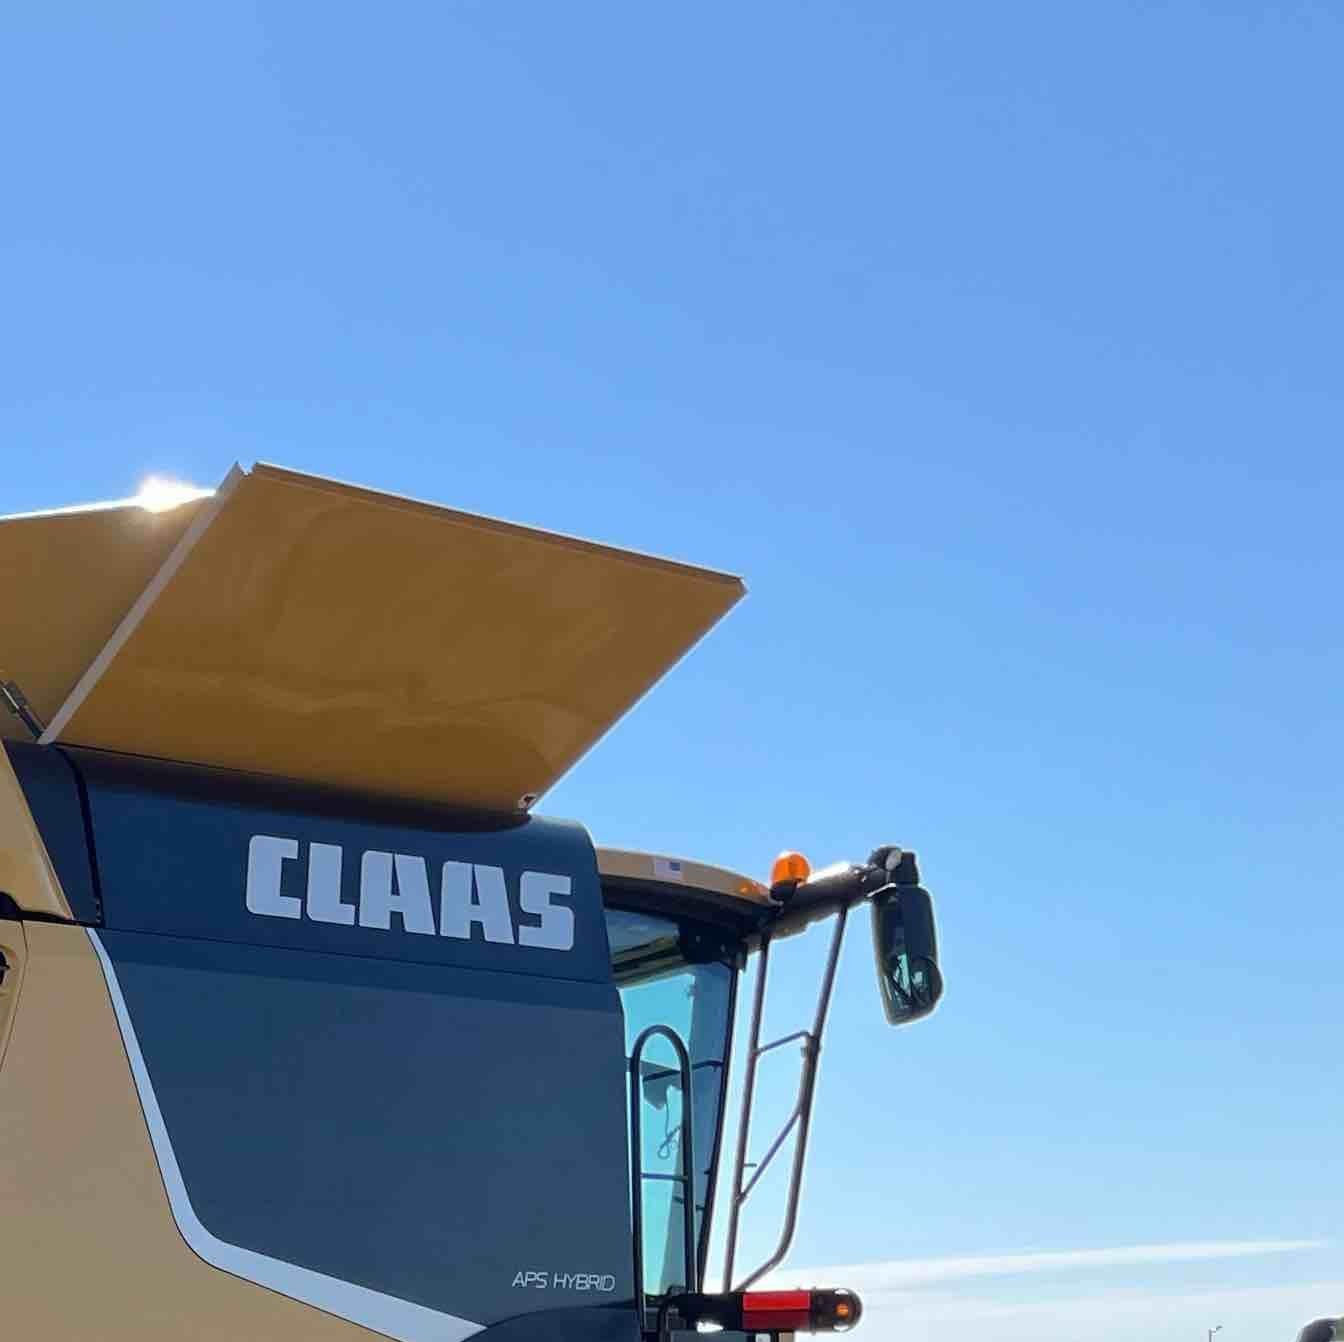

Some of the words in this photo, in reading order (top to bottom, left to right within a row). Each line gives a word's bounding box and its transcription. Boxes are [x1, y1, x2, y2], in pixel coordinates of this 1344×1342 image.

[247, 835, 574, 951] CLAAS
[511, 1271, 549, 1289] APS
[553, 1272, 616, 1292] HYBRID
